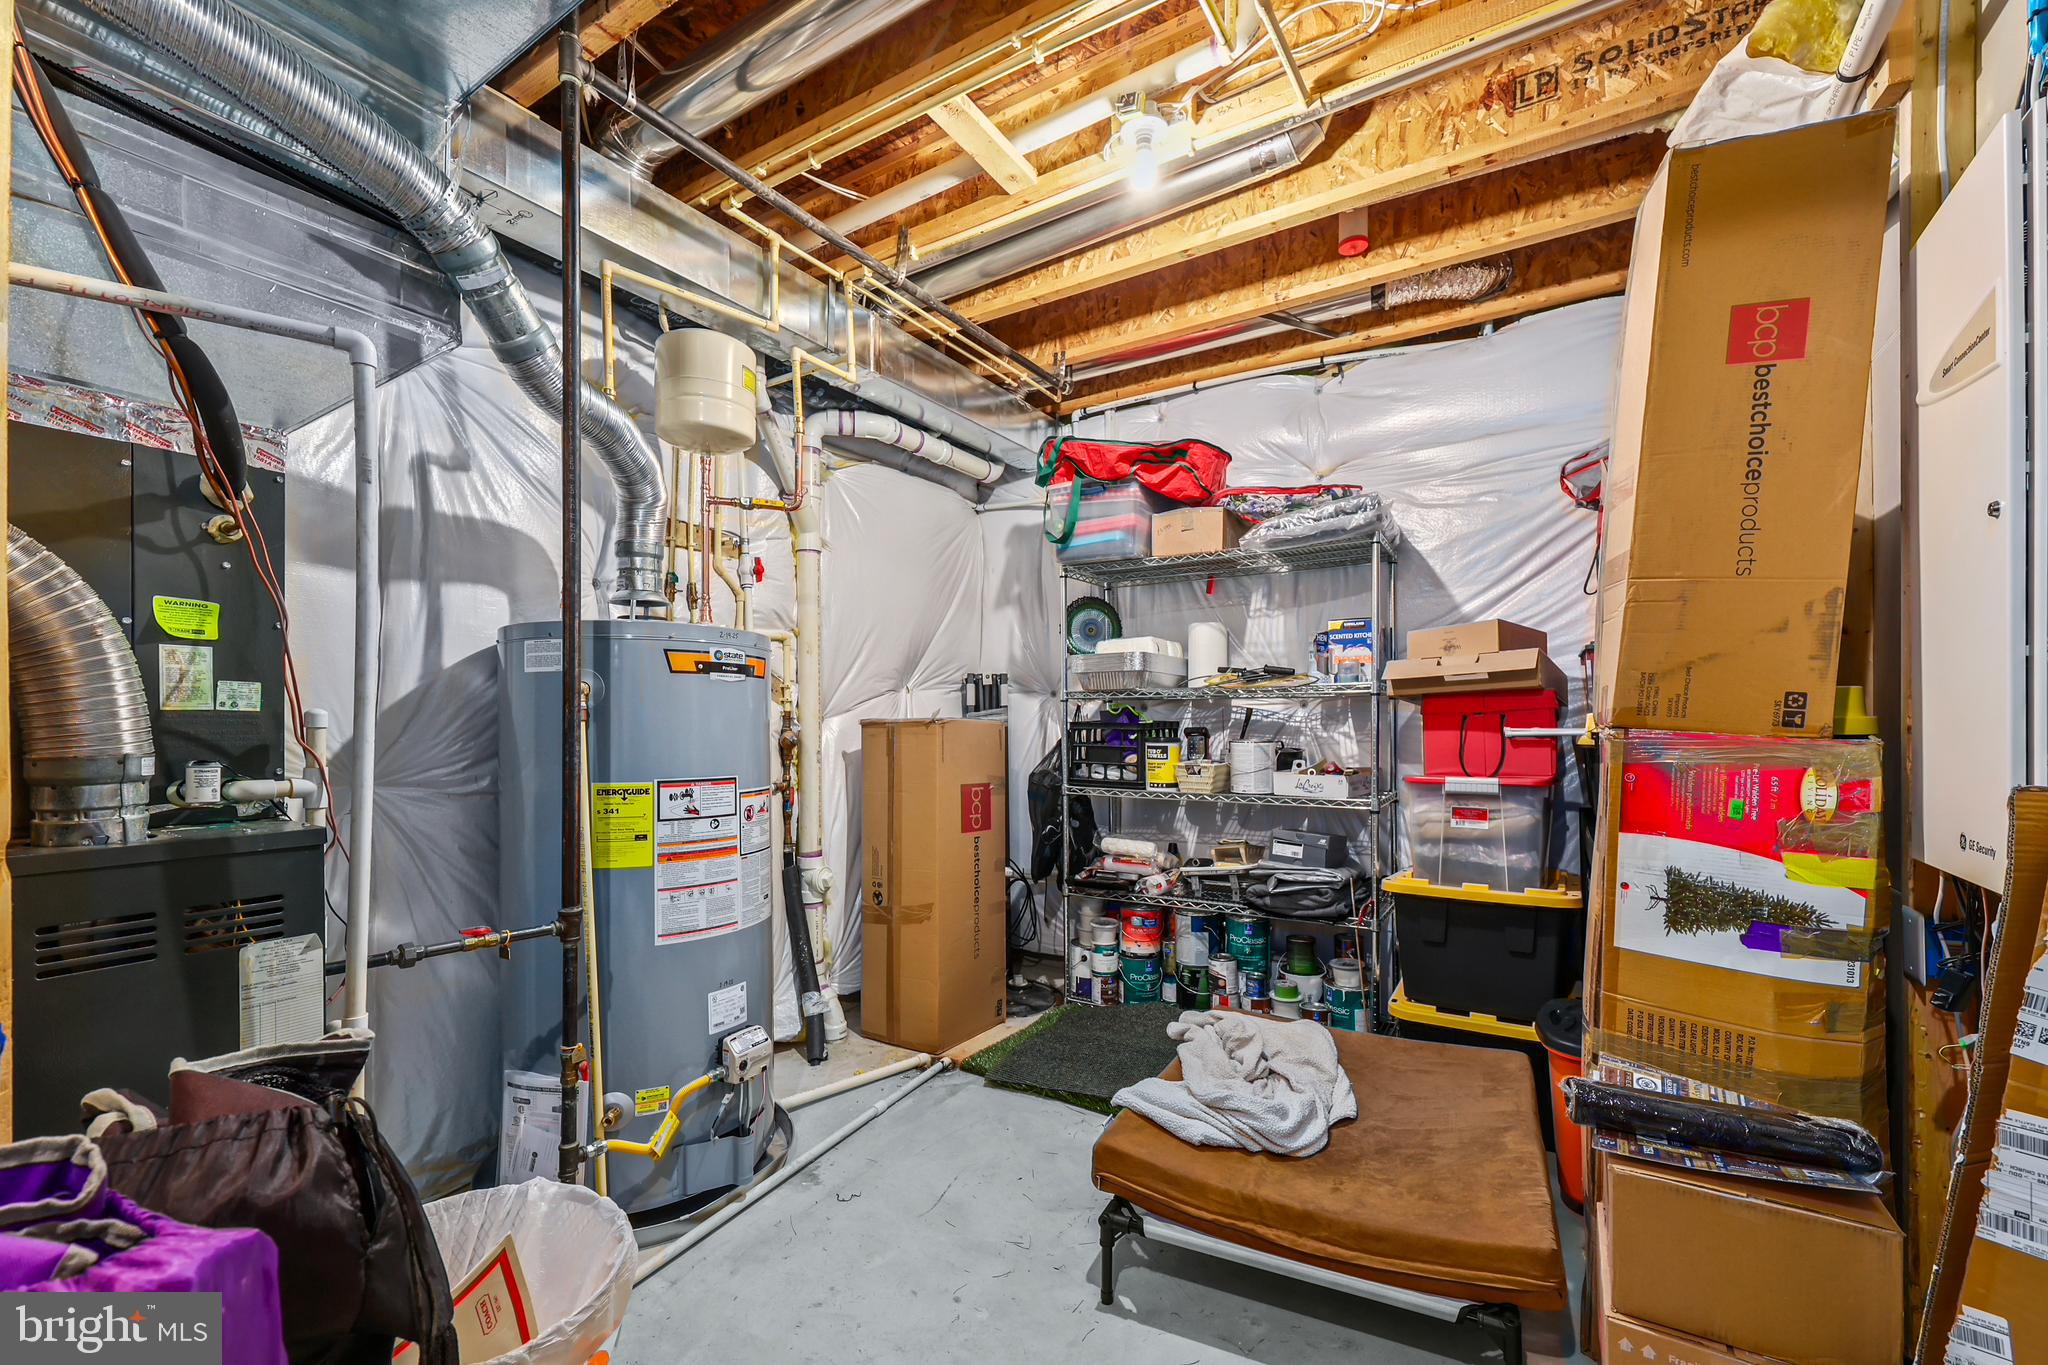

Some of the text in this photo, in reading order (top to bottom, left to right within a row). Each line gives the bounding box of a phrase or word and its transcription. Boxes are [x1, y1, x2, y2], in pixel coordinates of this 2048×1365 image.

[1848, 35, 1864, 58] PIPE
[1518, 67, 1559, 104] LP
[1681, 163, 1701, 268] bestchoiceproducts.com
[1746, 304, 1790, 348] bcp
[1942, 361, 1954, 378] Smart
[1735, 363, 1778, 577] bestchoiceproducts
[163, 599, 209, 609] WARNING
[723, 651, 744, 660] state
[1771, 699, 1783, 729] SKY6973
[596, 788, 651, 801] ENERGYGUIDE
[1751, 783, 1760, 807] Walden
[969, 786, 994, 830] bcp
[1750, 806, 1759, 821] Tree
[1968, 840, 1995, 861] GE Security
[972, 836, 982, 961] bestchoiceproducts
[1627, 1008, 1635, 1020] DATE
[1635, 1019, 1644, 1030] BOX
[1646, 1012, 1655, 1042] DISTRIBUTED
[1657, 1015, 1666, 1035] VENDOR
[1679, 1020, 1687, 1038] LOWE'S
[1690, 1023, 1698, 1039] CLEAR
[1712, 1028, 1721, 1045] MODEL
[1723, 1030, 1732, 1062] COUNTRY OF
[2009, 1163, 2036, 1177] CHURCH
[480, 1299, 493, 1330] COACH
